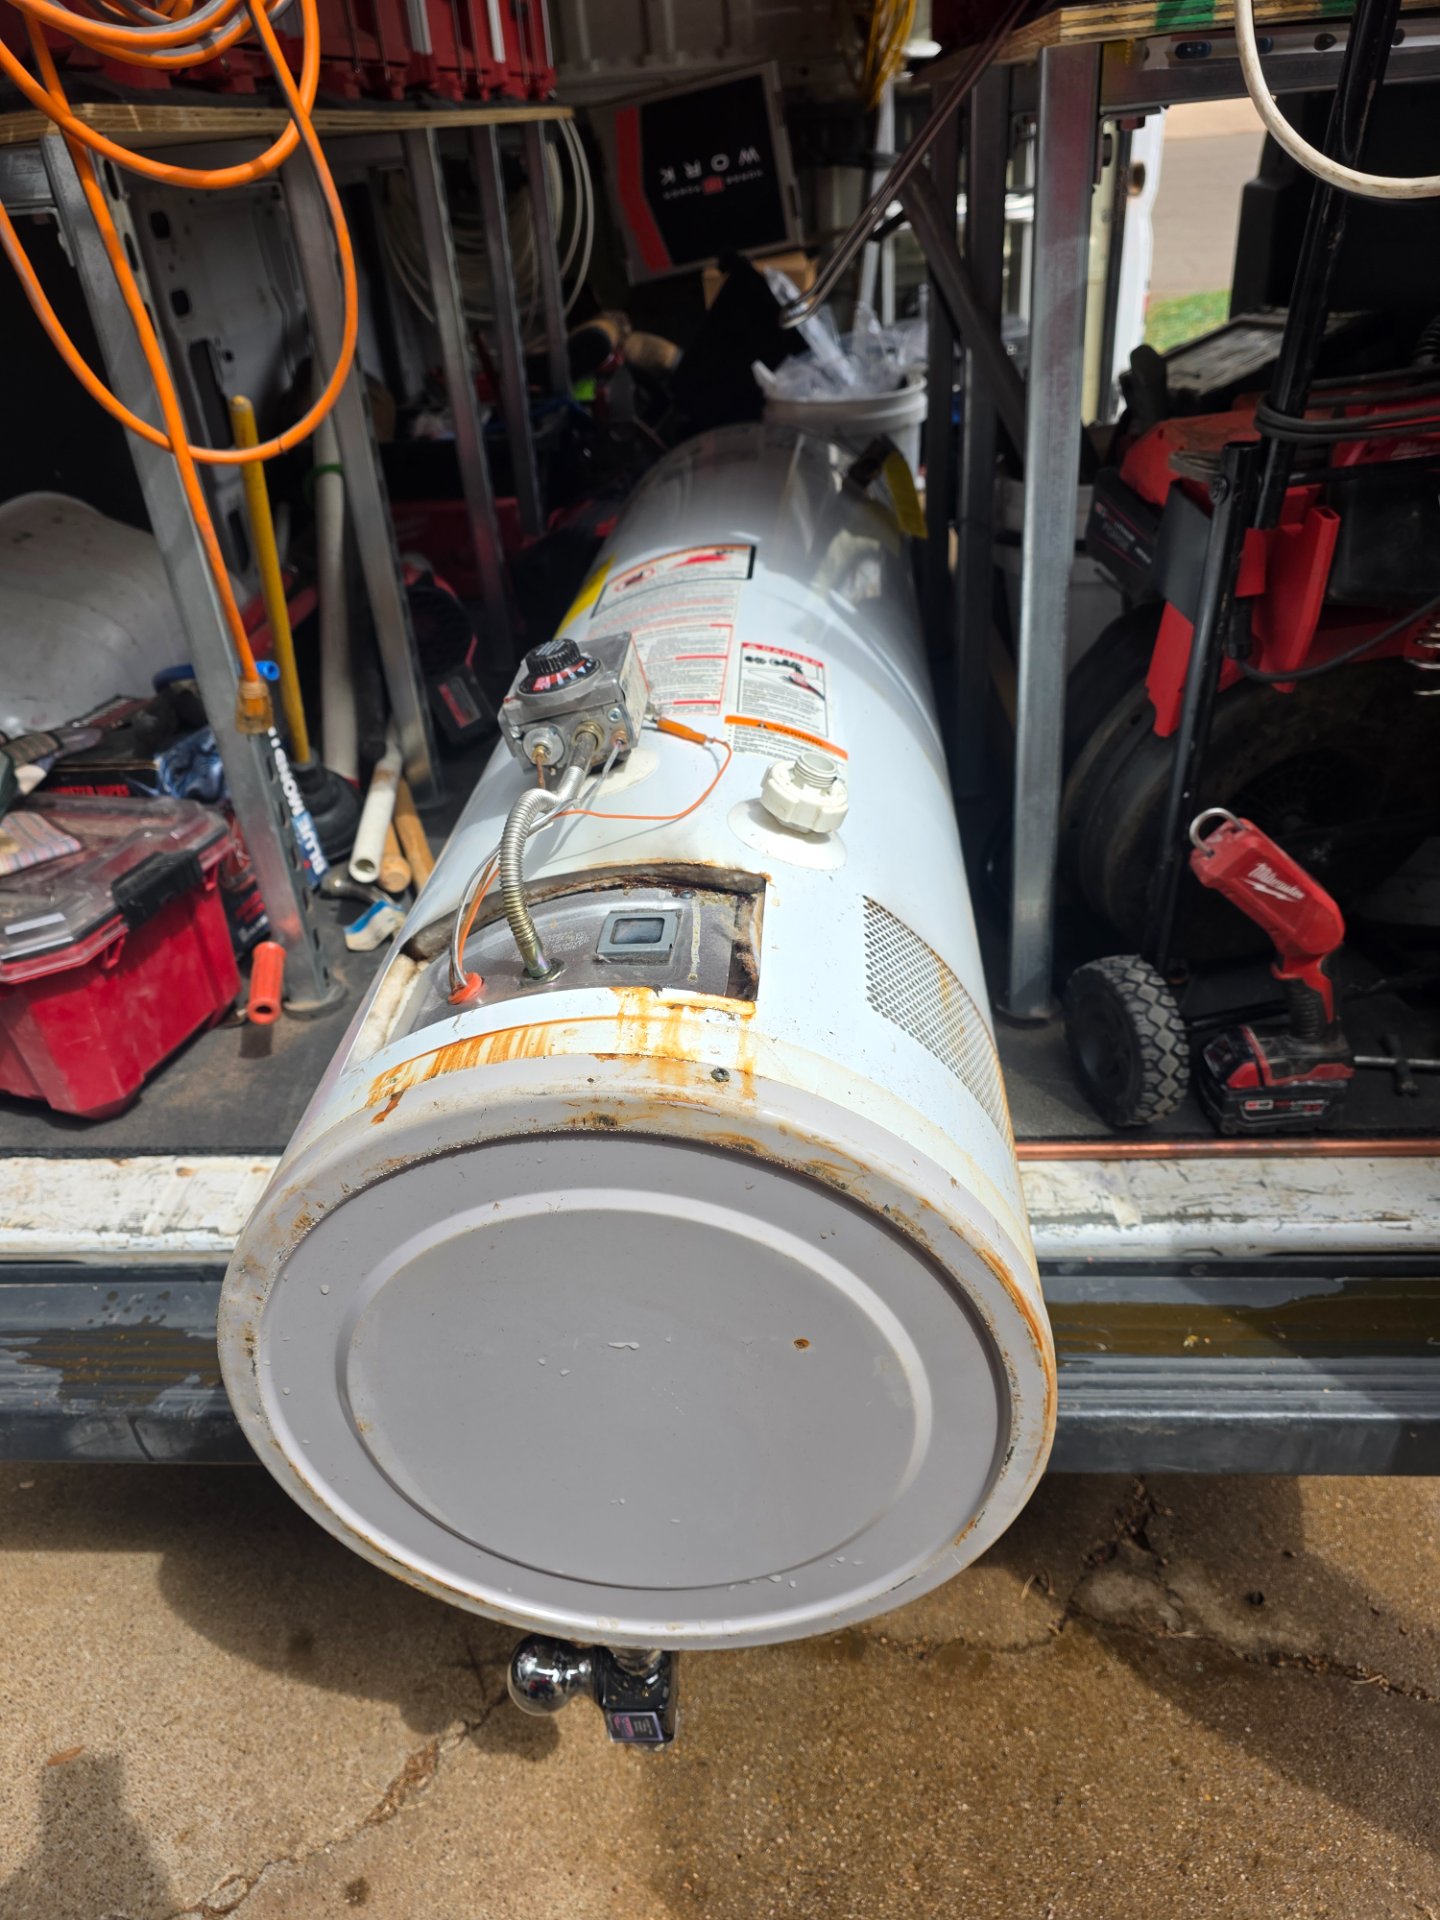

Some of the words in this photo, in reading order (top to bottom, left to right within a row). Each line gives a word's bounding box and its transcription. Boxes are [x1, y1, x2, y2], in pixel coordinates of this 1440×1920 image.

[659, 146, 760, 187] WORK
[773, 726, 823, 747] WARNING
[296, 815, 328, 876] BLUE
